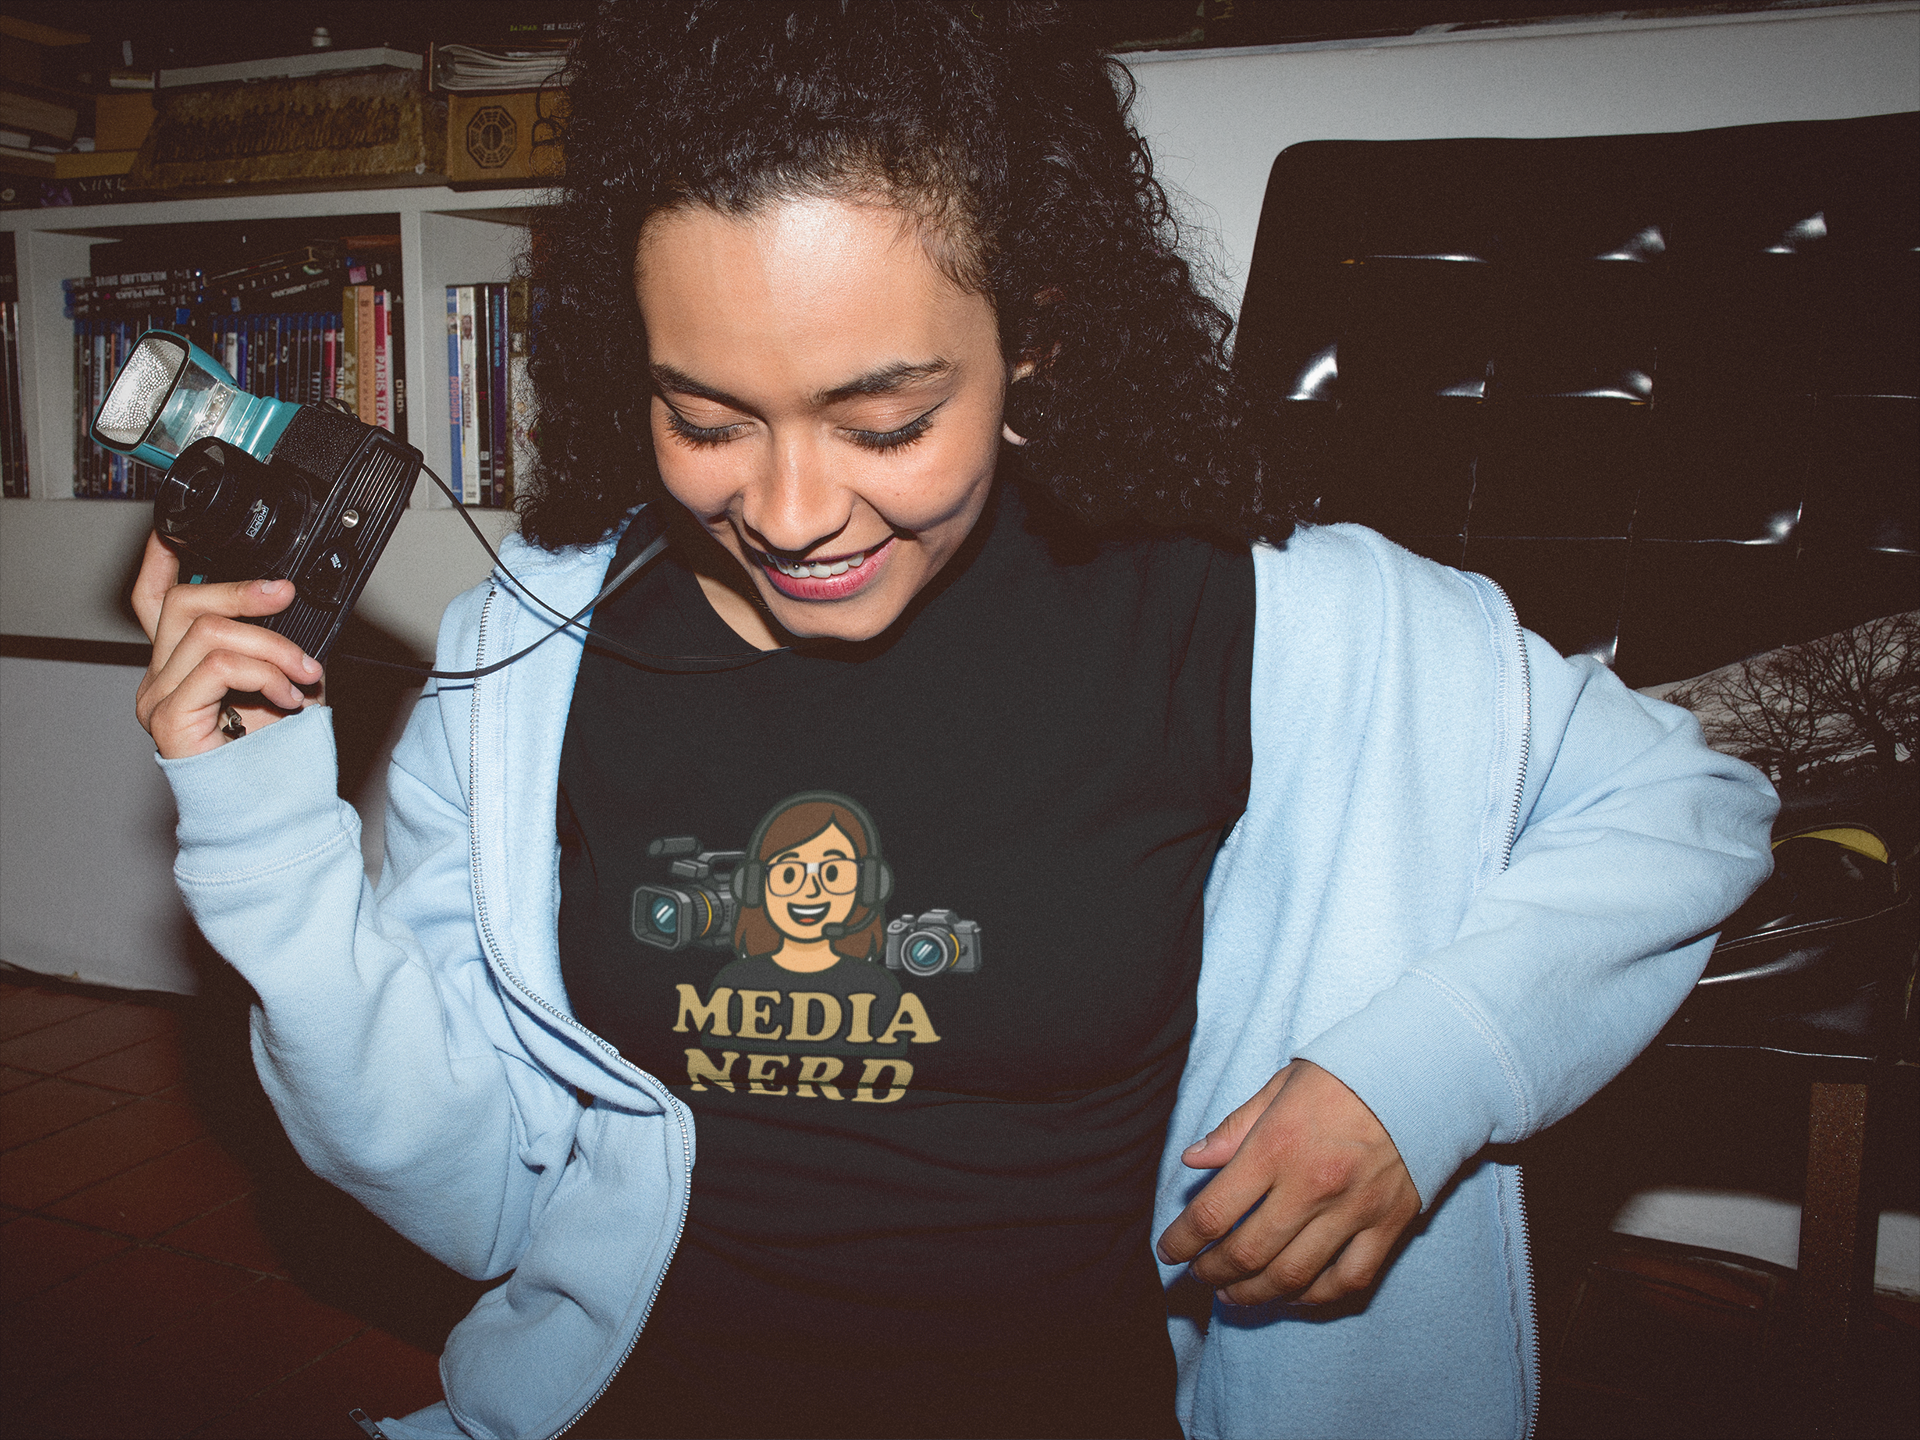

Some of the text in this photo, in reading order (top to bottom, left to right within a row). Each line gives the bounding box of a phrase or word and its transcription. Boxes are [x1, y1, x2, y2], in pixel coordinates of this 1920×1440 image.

[542, 23, 555, 31] THE
[375, 355, 388, 427] PARIS, TEXA
[449, 375, 460, 425] Felicidad
[672, 983, 942, 1104] MEDIA NERD
